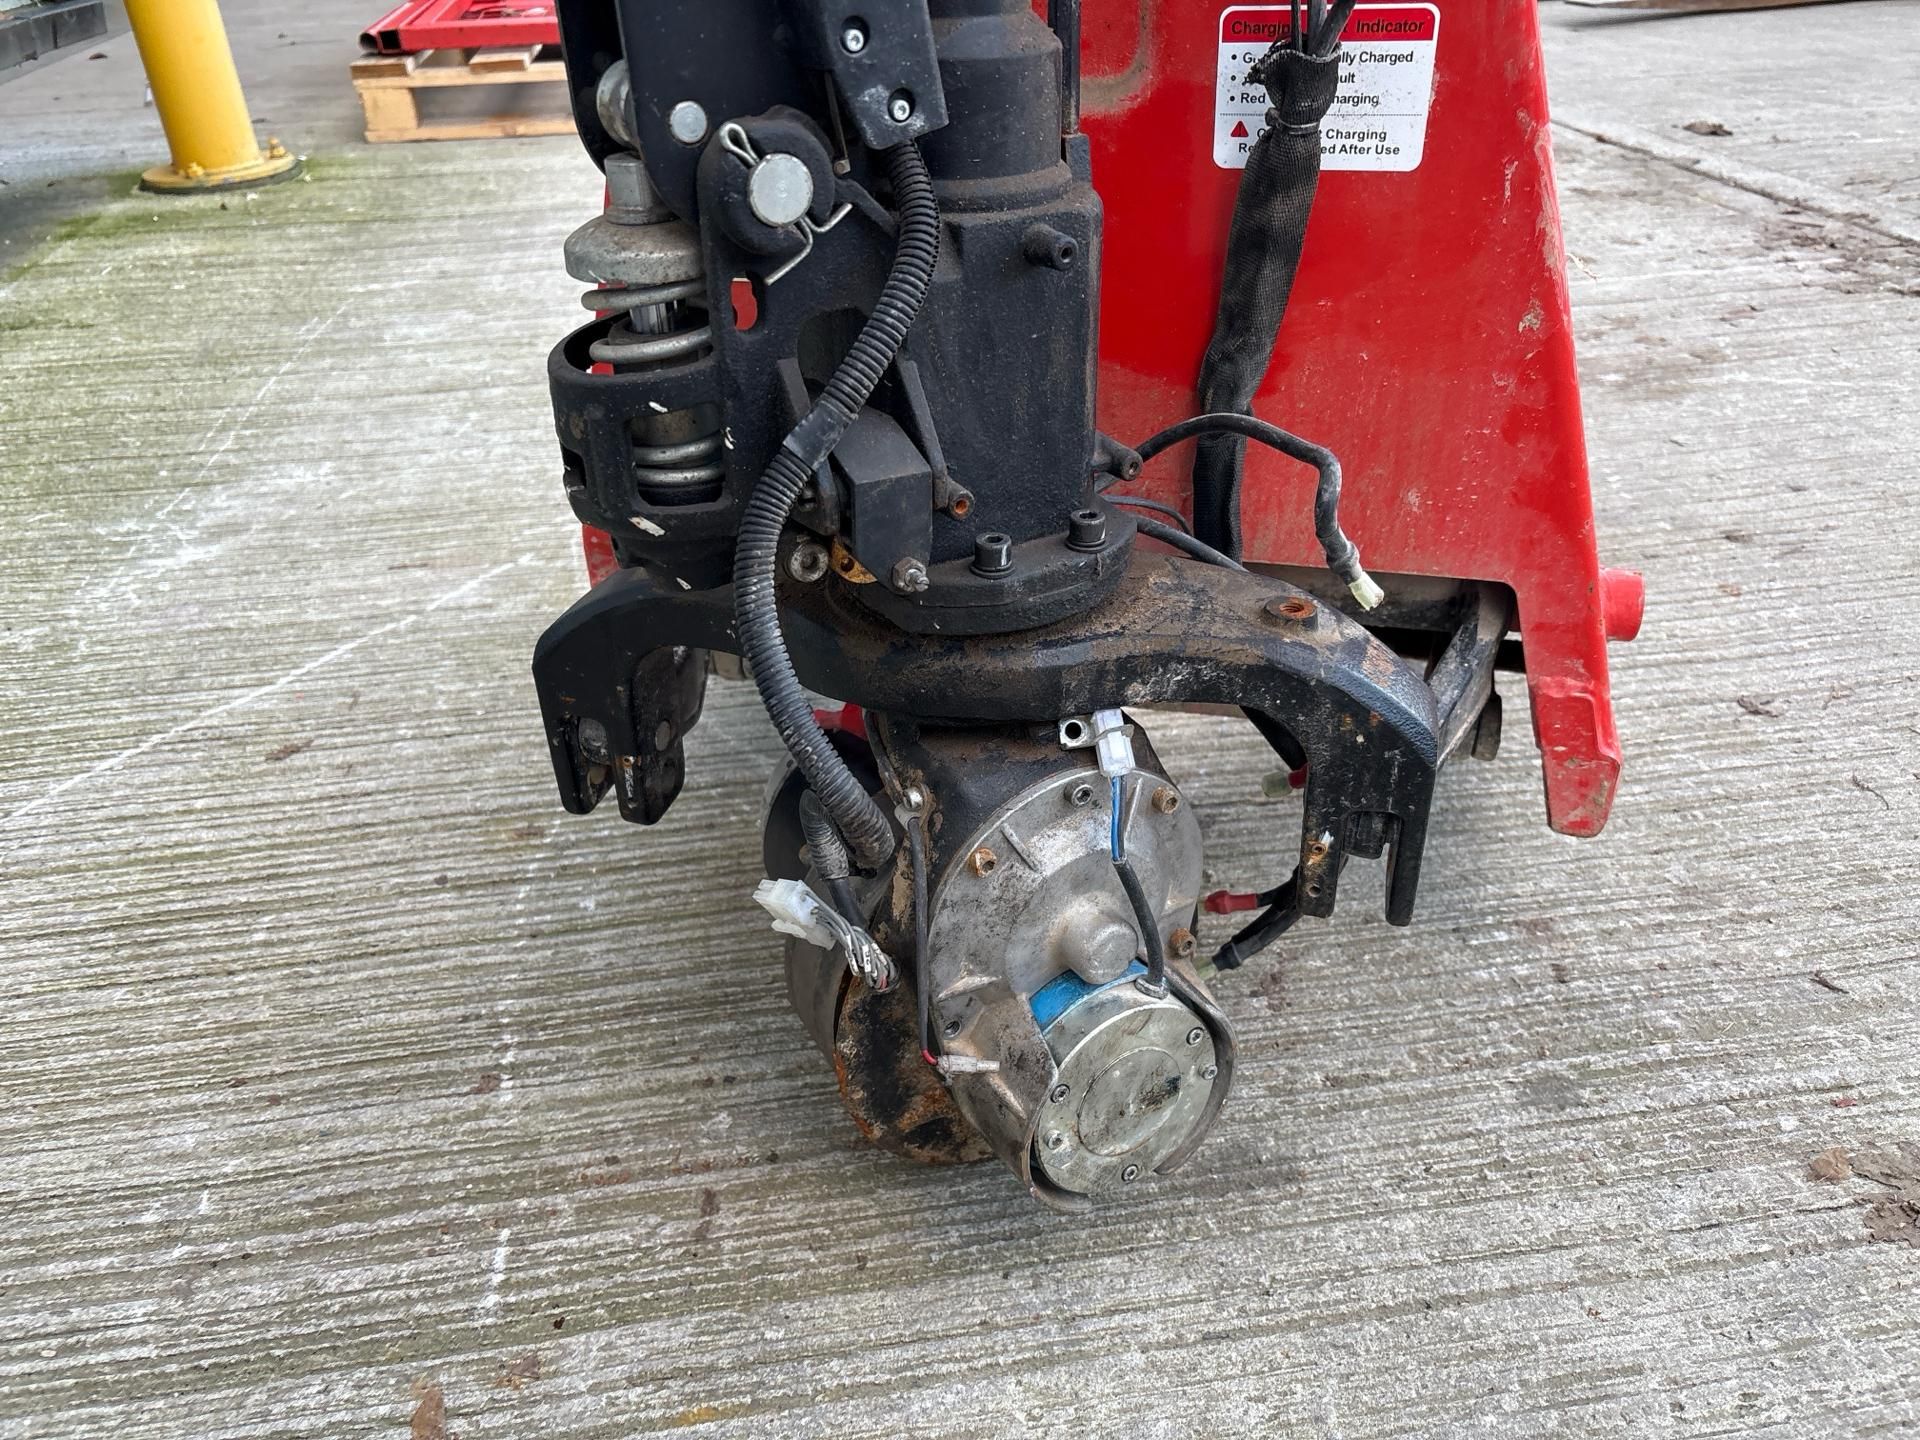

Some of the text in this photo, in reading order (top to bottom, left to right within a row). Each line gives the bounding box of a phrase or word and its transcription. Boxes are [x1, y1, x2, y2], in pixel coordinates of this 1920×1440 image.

[1231, 21, 1291, 37] Chargin
[1357, 19, 1424, 33] Indicator
[1359, 51, 1414, 65] Charged
[1340, 72, 1355, 83] ult
[1240, 92, 1379, 107] Red harging
[1326, 128, 1387, 142] Charging
[1339, 144, 1371, 154] After
[1375, 144, 1400, 154] Use
